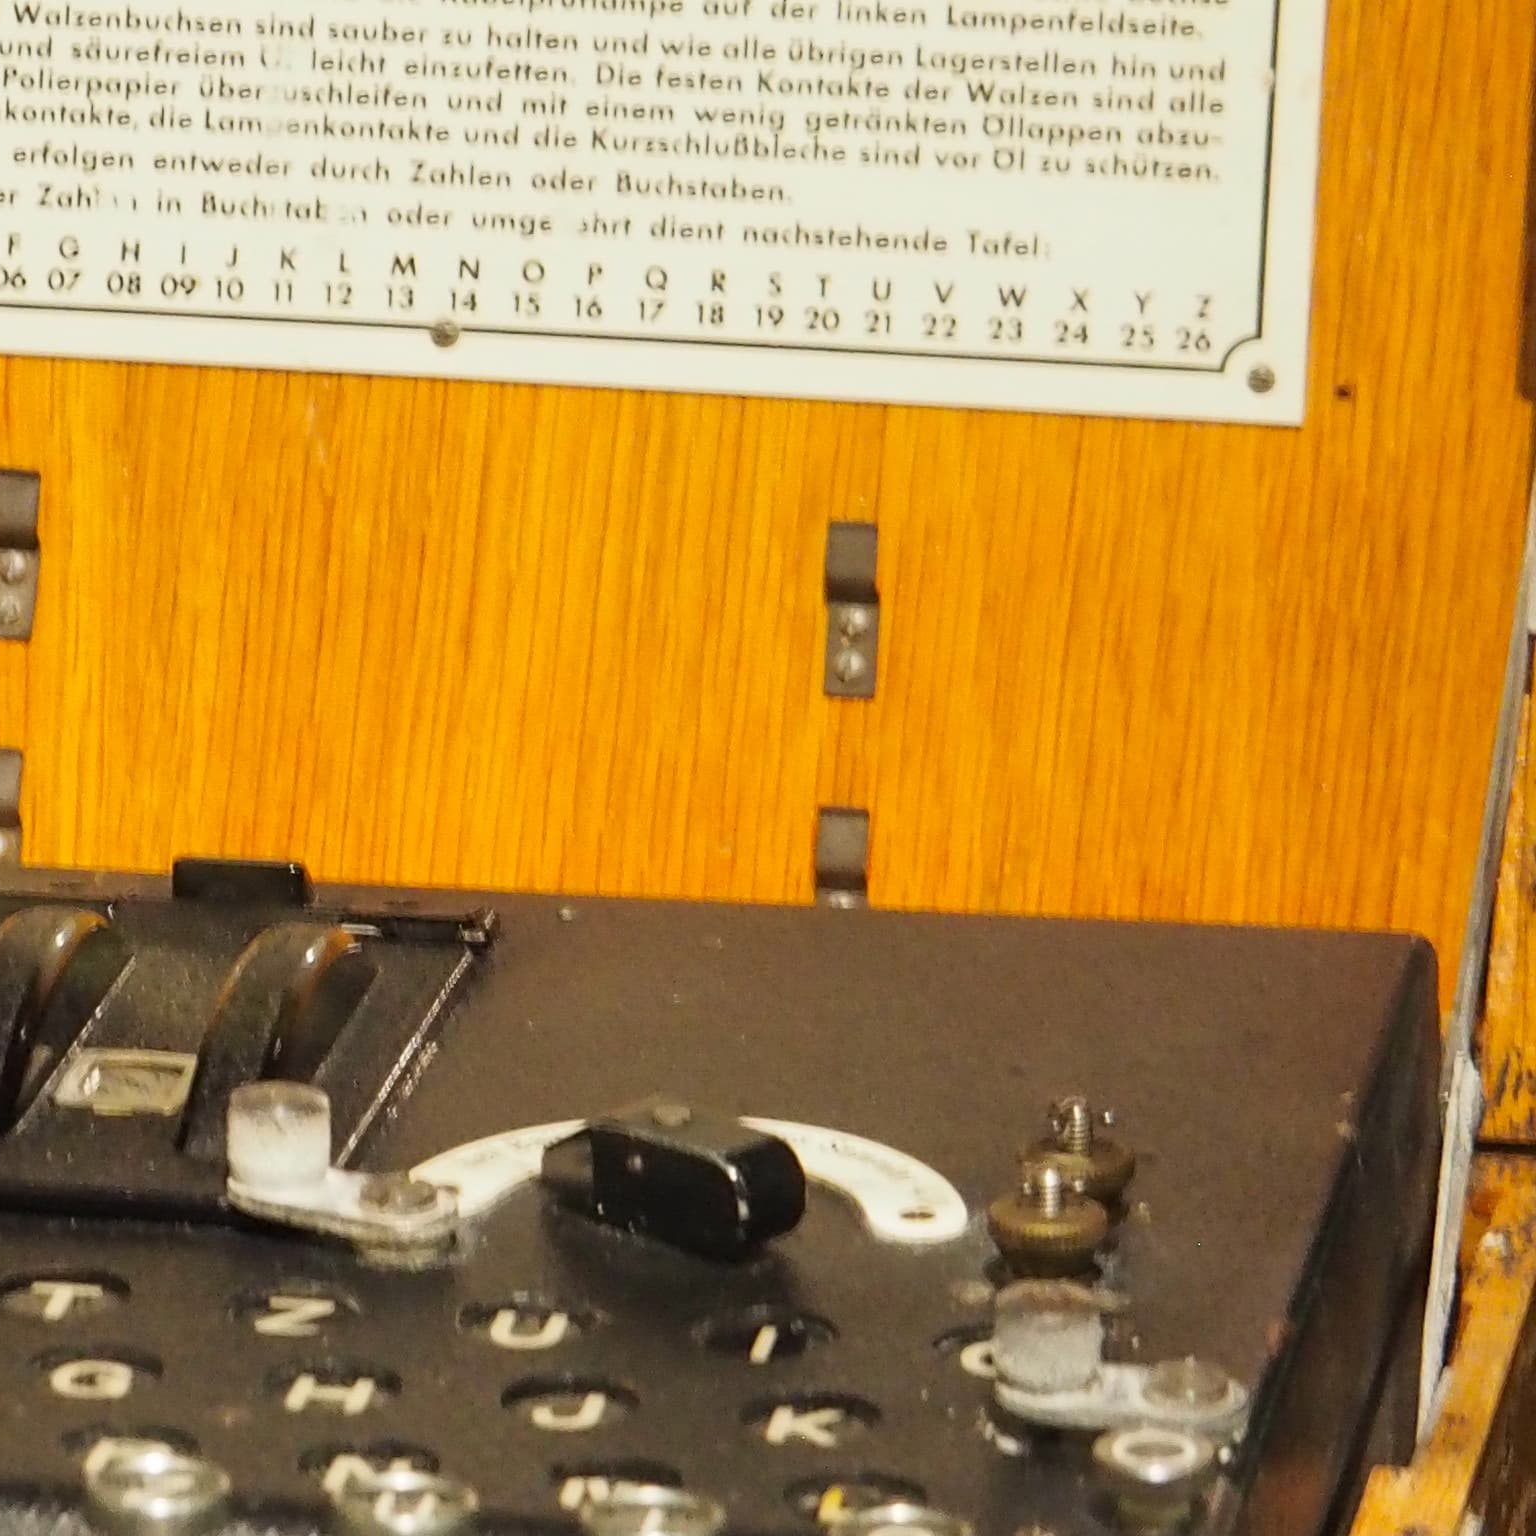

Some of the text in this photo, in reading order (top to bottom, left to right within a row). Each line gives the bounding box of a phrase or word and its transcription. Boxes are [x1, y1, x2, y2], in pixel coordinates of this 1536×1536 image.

[10, 138, 135, 175] erfolgen
[151, 150, 291, 178] entweder
[308, 152, 391, 183] durch
[408, 158, 512, 189] Zahlen
[529, 164, 597, 193] oder
[30, 1280, 105, 1323] T
[487, 1308, 570, 1351] U
[748, 1324, 779, 1365] I
[282, 1373, 377, 1416] H
[529, 1391, 608, 1433] J
[764, 1405, 840, 1448] K
